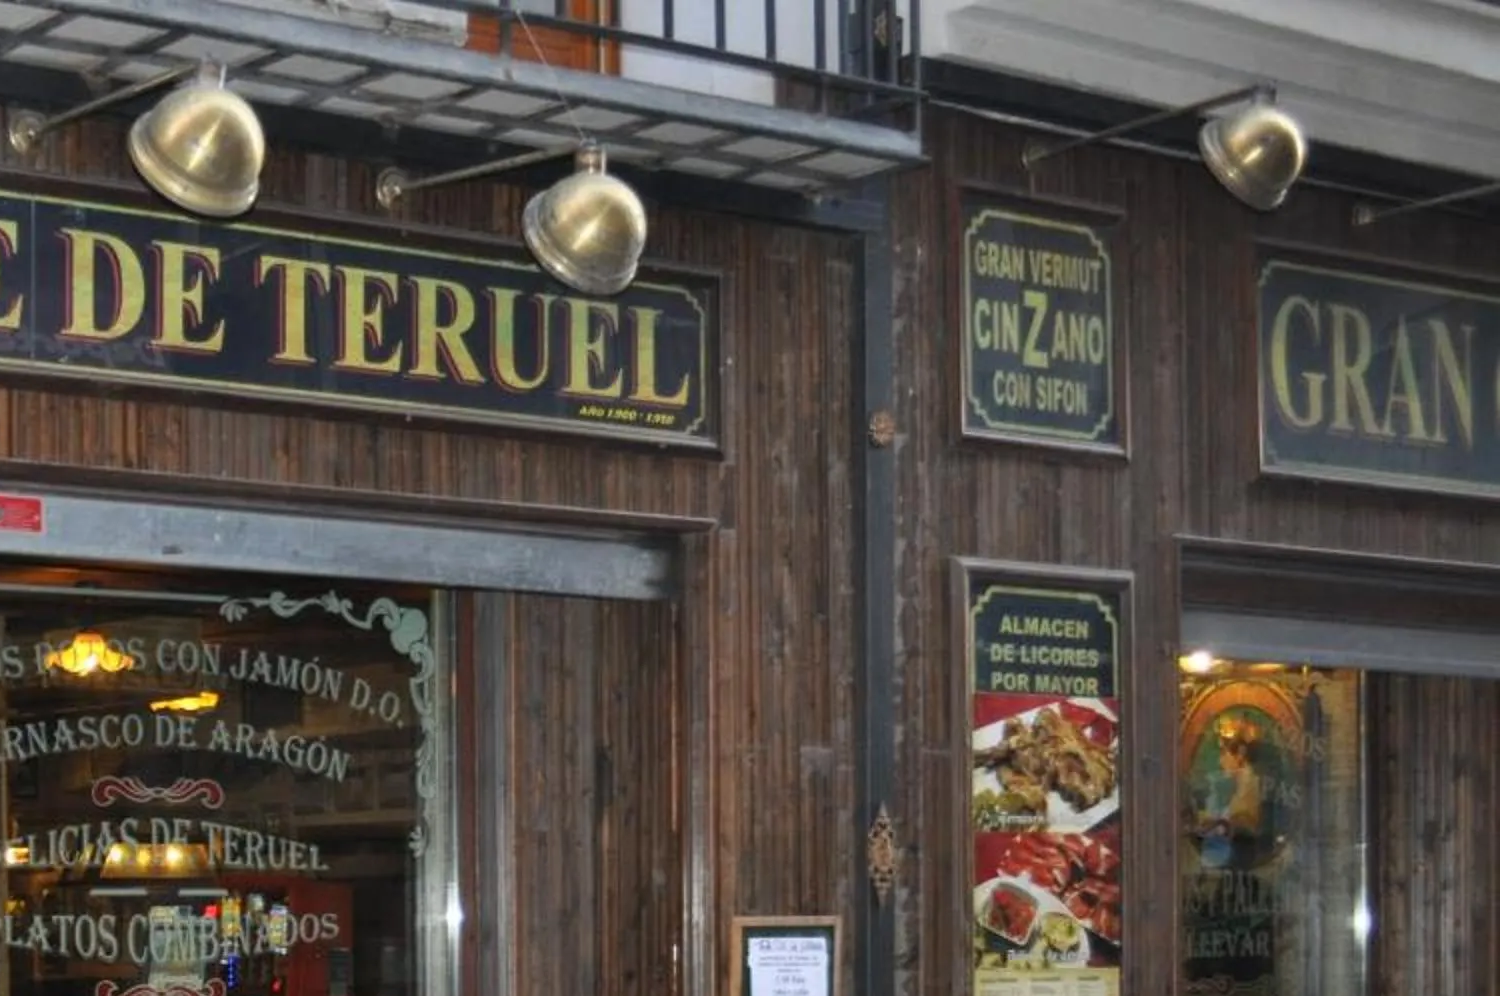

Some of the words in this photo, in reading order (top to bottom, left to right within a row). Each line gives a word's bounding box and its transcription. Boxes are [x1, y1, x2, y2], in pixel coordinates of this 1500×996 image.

[974, 240, 1024, 279] GRAN
[1028, 250, 1101, 294] VERMUT
[56, 226, 226, 359] DE
[254, 252, 691, 406] TERUEL
[973, 291, 1104, 368] CINZANO
[993, 371, 1031, 408] CON
[1036, 375, 1088, 415] SIFON
[1271, 295, 1475, 452] GRAN
[1000, 615, 1089, 640] ALMACEN
[156, 638, 222, 677] CON
[230, 646, 344, 703] JAMÓN
[990, 643, 1016, 664] DE
[1019, 646, 1100, 669] LICORES
[990, 672, 1030, 694] POR
[1035, 674, 1100, 697] MAYOR
[154, 713, 198, 750] DE
[207, 720, 353, 783] ARAGÓN
[200, 820, 330, 871] TERUEL
